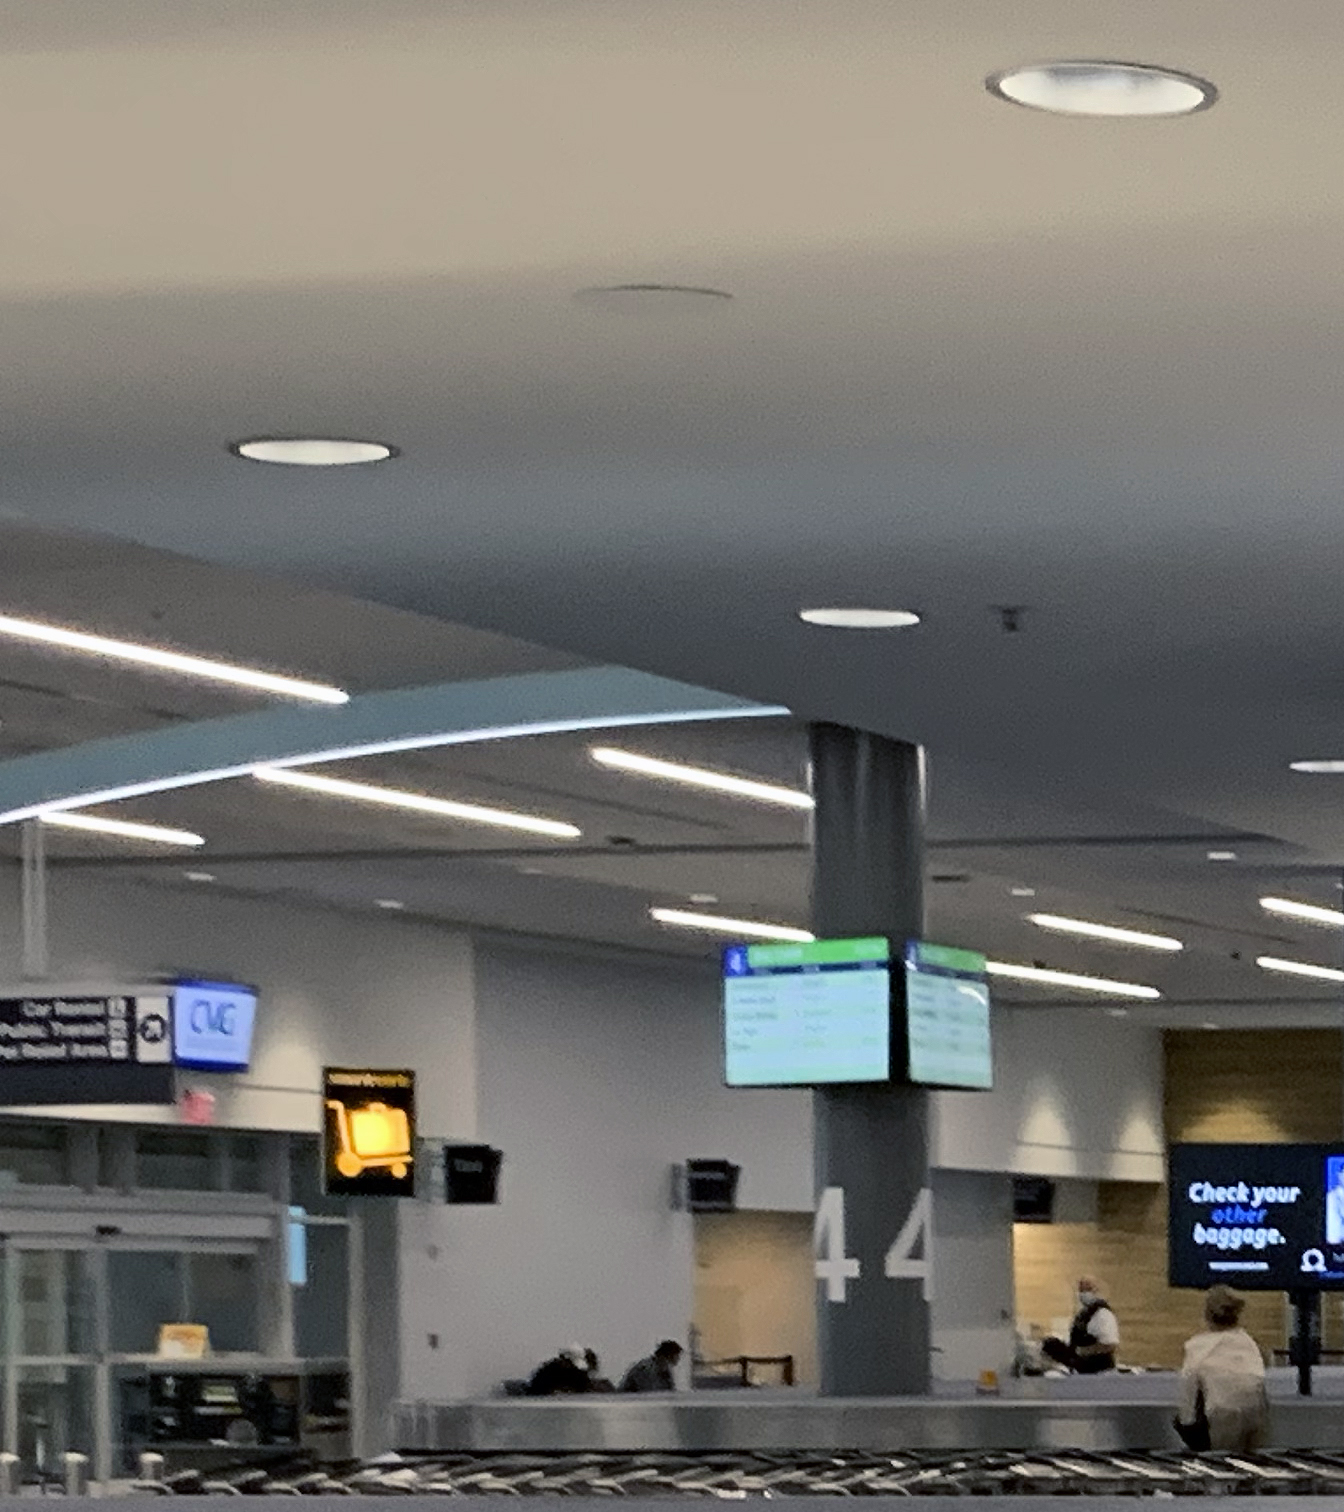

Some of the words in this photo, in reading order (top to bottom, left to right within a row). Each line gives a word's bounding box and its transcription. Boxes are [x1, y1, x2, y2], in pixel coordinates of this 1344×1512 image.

[1188, 1181, 1250, 1203] Check
[1250, 1185, 1300, 1208] your
[1211, 1204, 1268, 1224] other
[814, 1186, 860, 1303] 4
[884, 1187, 933, 1302] 4
[1193, 1223, 1286, 1250] baggage.
